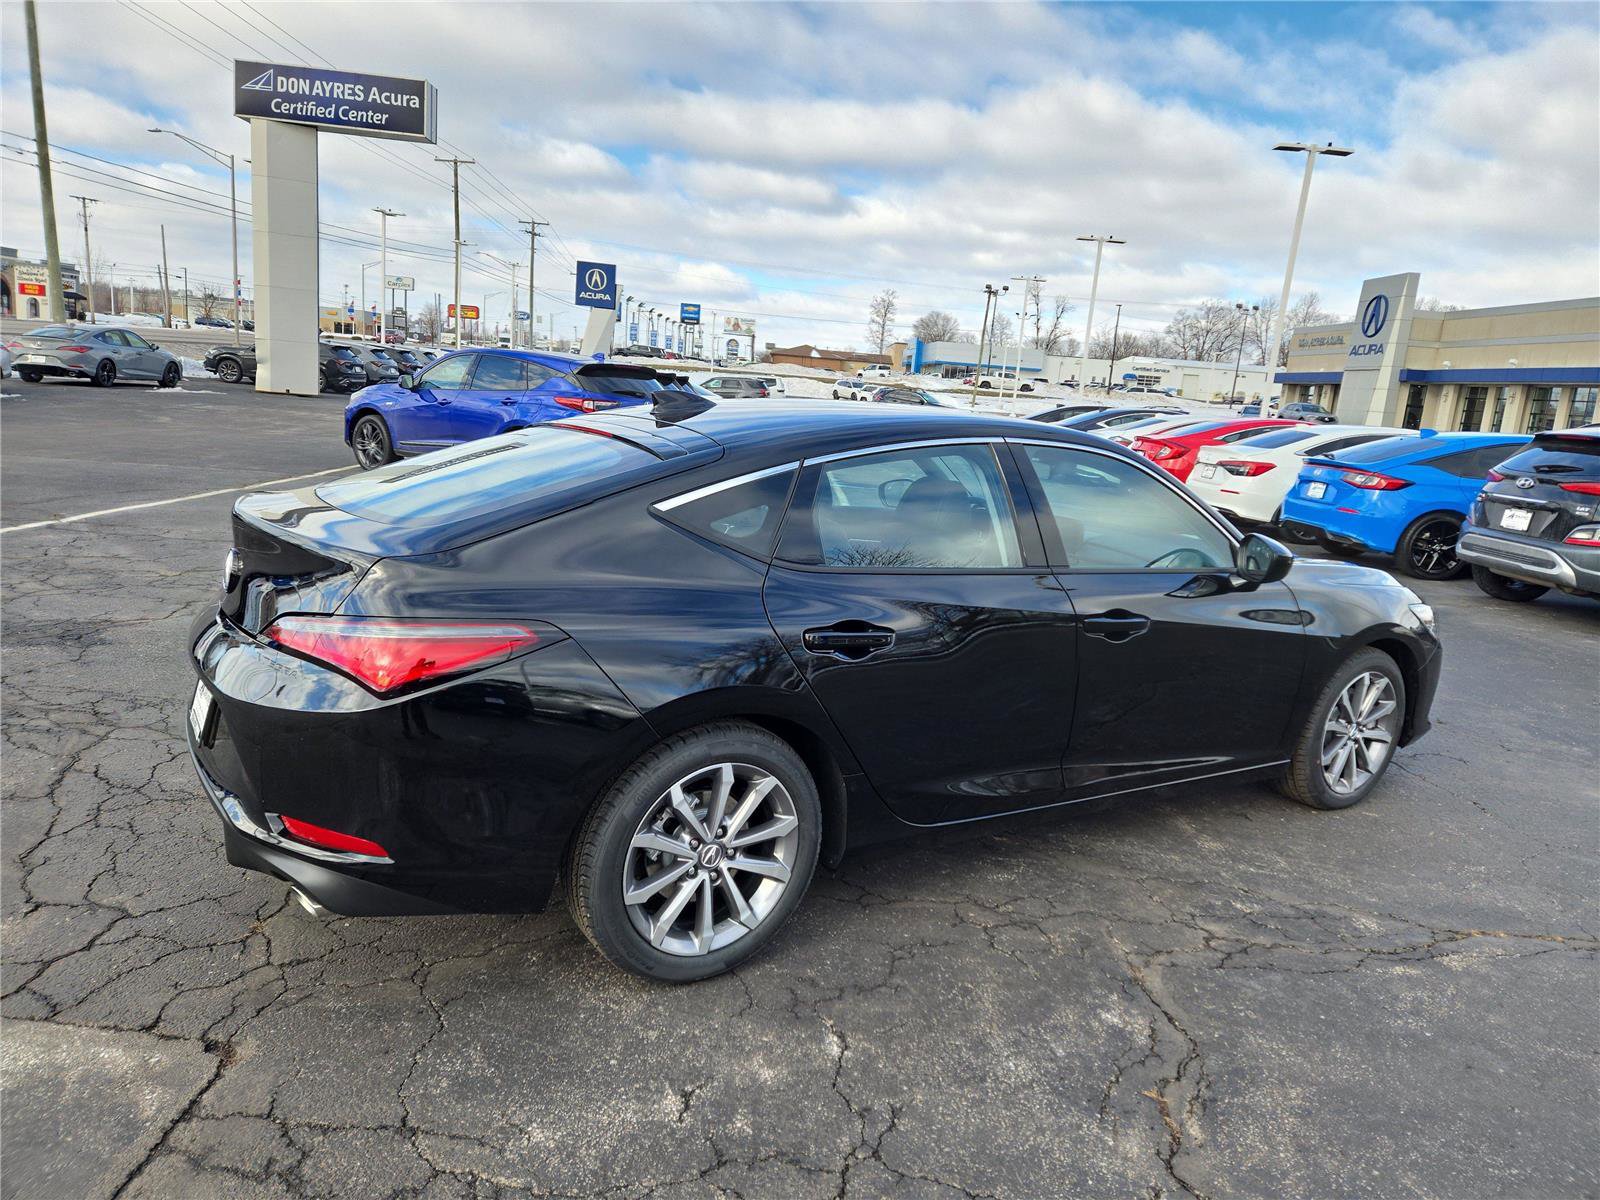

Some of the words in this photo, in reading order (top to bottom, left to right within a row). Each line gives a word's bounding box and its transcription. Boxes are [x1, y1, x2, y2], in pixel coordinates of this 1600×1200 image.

[277, 76, 310, 95] DON
[312, 80, 364, 101] AYRES
[368, 87, 420, 108] Acura
[271, 98, 335, 119] Certified
[338, 105, 389, 125] Center
[579, 291, 611, 301] ACURA
[1349, 343, 1384, 356] ACURA
